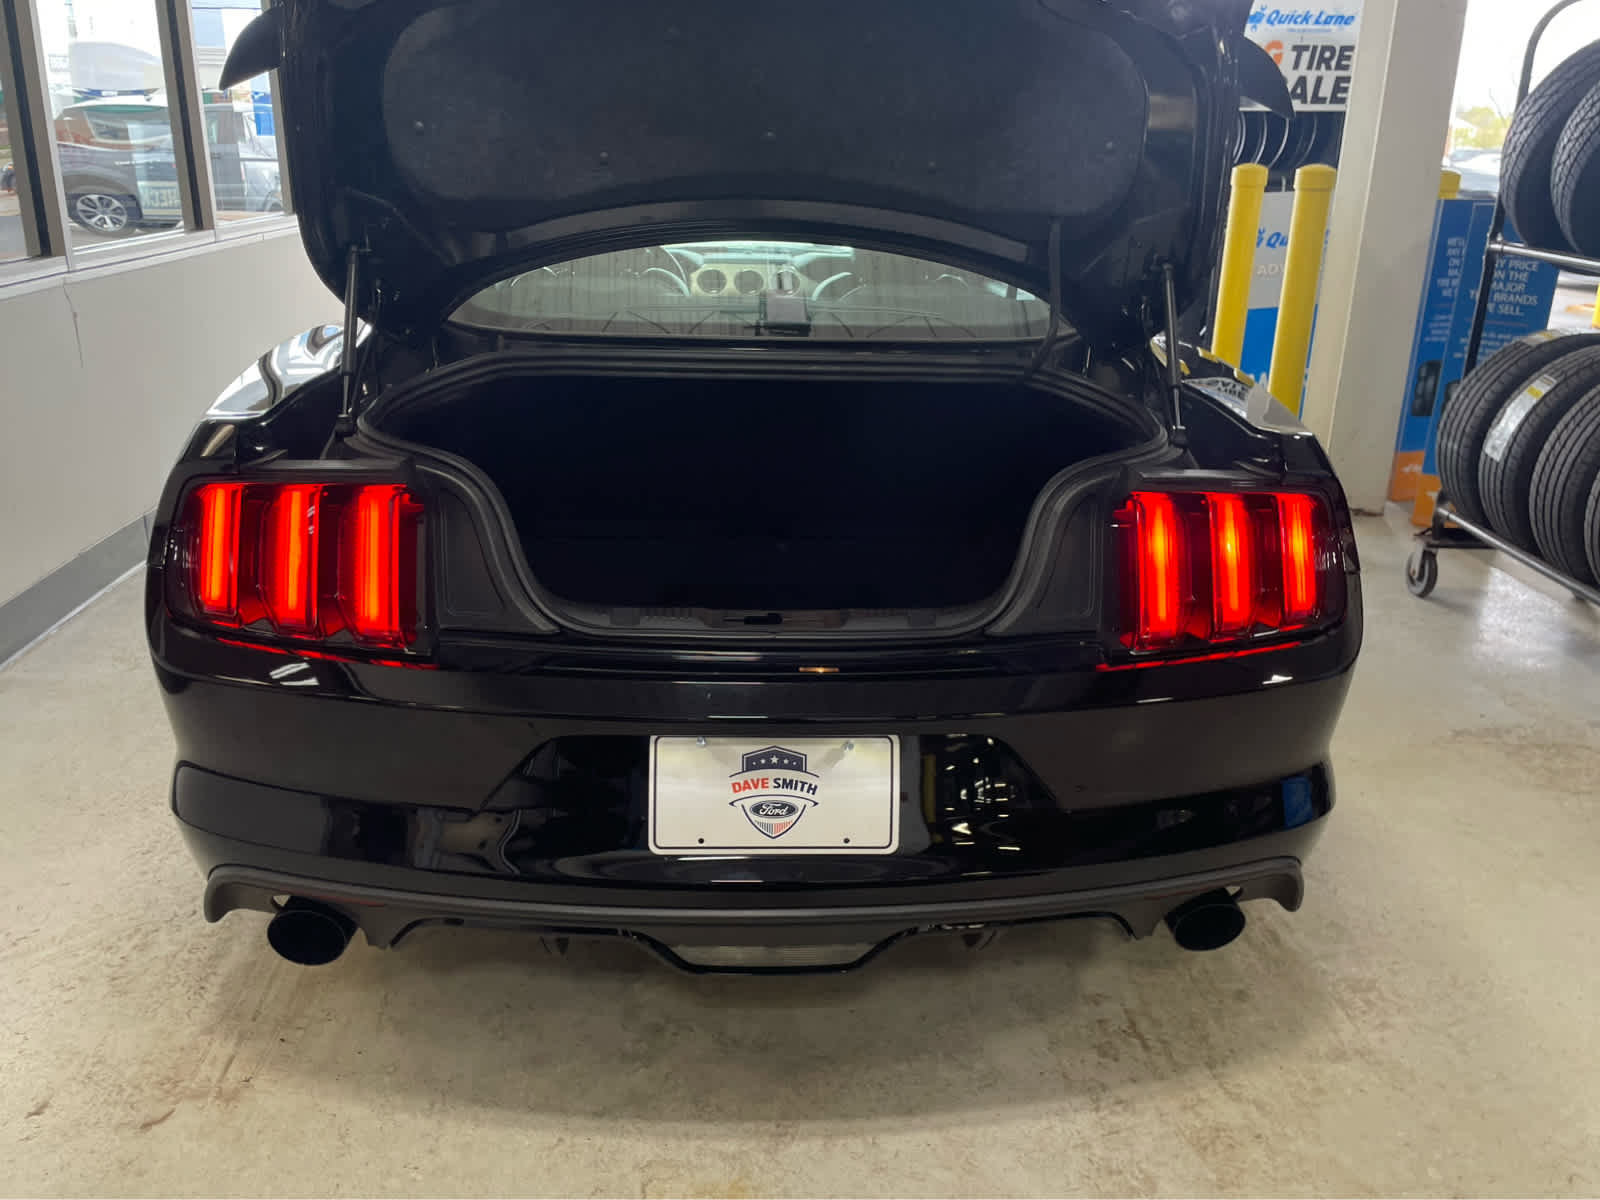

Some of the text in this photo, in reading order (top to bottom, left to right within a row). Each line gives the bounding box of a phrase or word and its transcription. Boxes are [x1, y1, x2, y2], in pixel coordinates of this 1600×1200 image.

[1266, 9, 1355, 27] Quick Lane
[1291, 45, 1355, 71] TIRE
[1290, 75, 1352, 105] ALE
[1509, 259, 1539, 272] PRICE
[1494, 293, 1538, 306] BRANDS
[731, 777, 818, 796] DAVE SMITH
[759, 803, 790, 816] Ford
